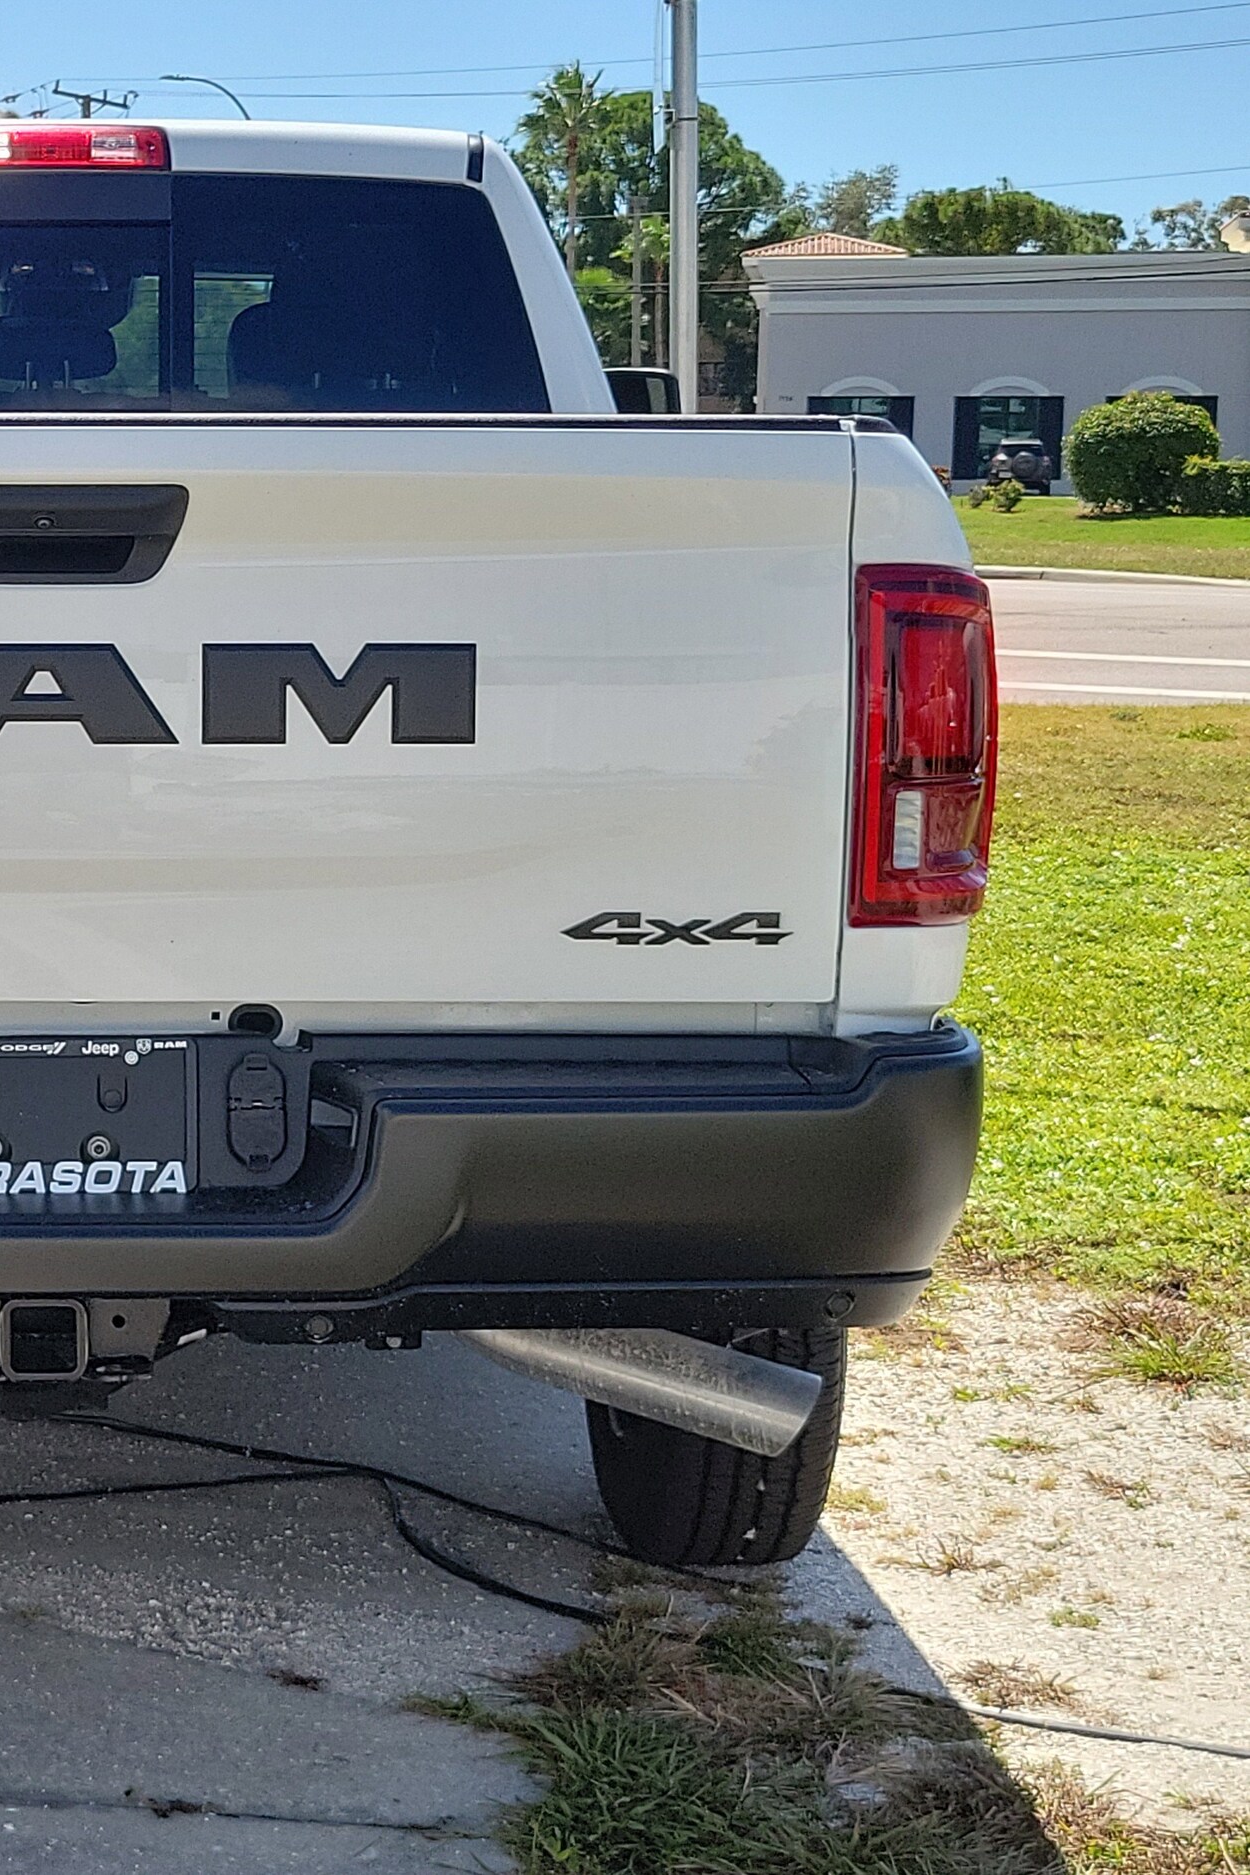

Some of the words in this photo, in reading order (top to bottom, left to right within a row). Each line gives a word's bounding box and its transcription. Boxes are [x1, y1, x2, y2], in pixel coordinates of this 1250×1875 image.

[559, 911, 795, 946] 4x4
[81, 1040, 120, 1057] Jeep
[153, 1040, 188, 1049] RAM
